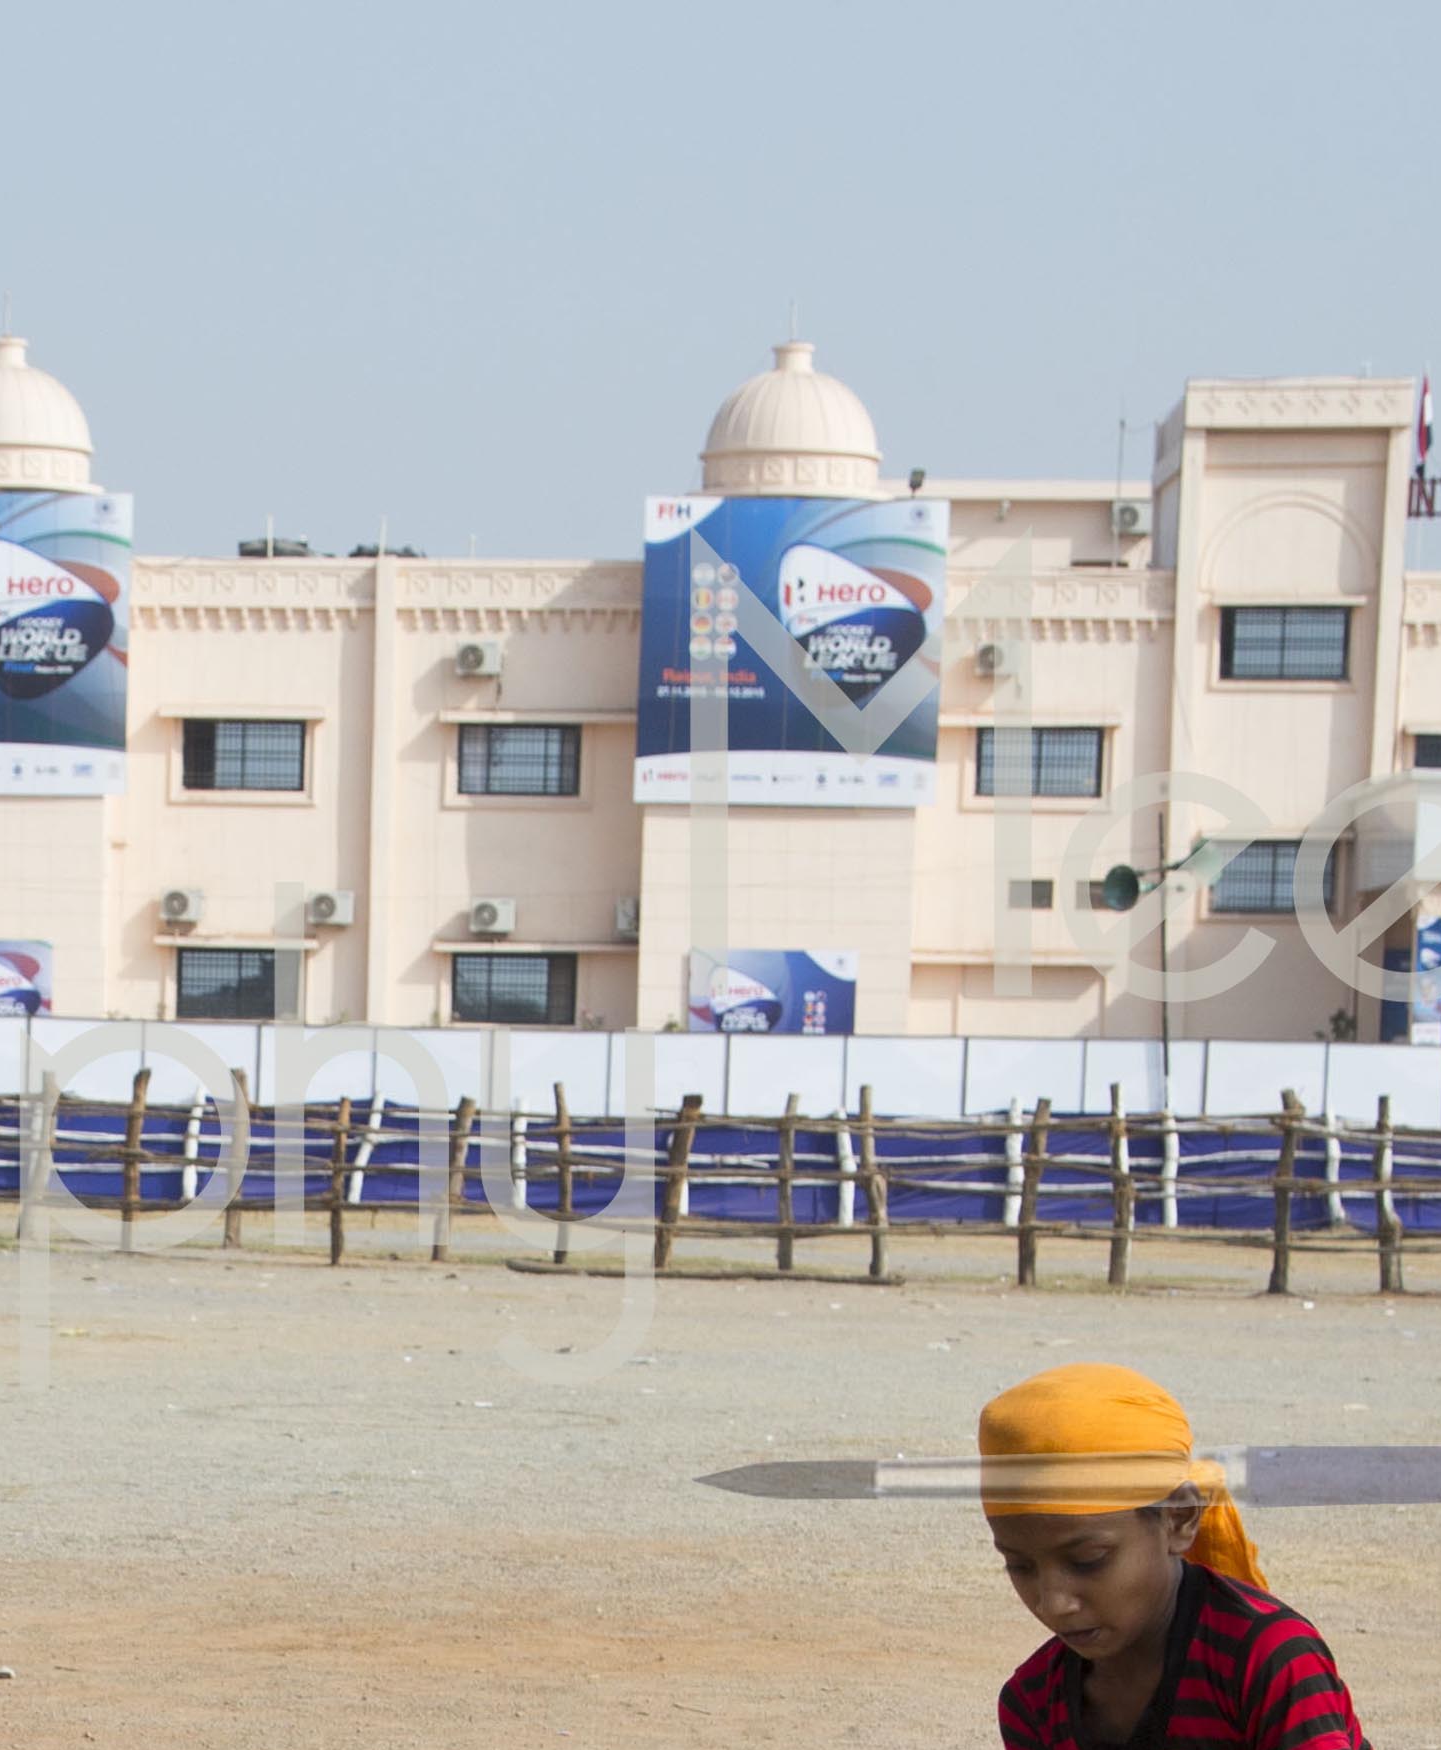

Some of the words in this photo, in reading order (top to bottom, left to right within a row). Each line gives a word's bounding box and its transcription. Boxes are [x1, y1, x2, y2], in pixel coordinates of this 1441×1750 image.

[8, 575, 74, 595] Hero
[818, 582, 886, 602] Hero
[0, 627, 83, 646] WORLD
[808, 635, 893, 654] WORLD
